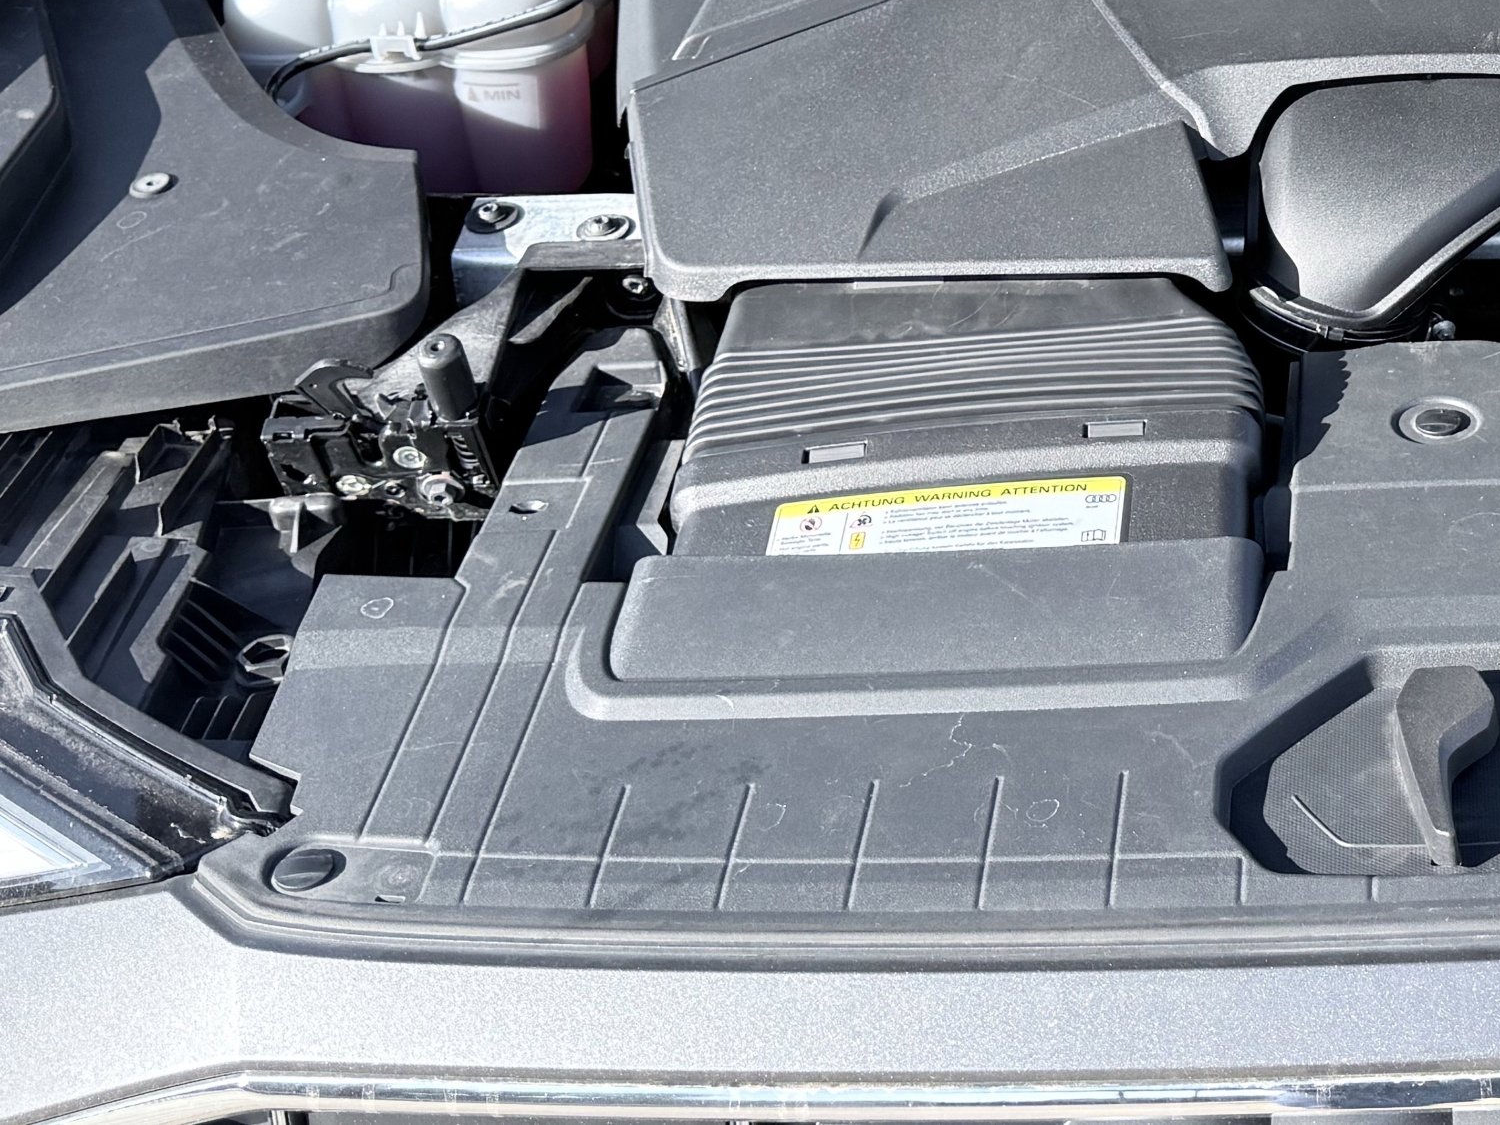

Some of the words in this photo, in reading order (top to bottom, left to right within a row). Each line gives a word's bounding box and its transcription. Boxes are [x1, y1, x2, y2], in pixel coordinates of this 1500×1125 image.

[483, 89, 521, 101] MIN
[828, 496, 905, 512] ACHTUNG
[914, 488, 992, 503] WARNING
[1000, 483, 1088, 496] ATTENTION
